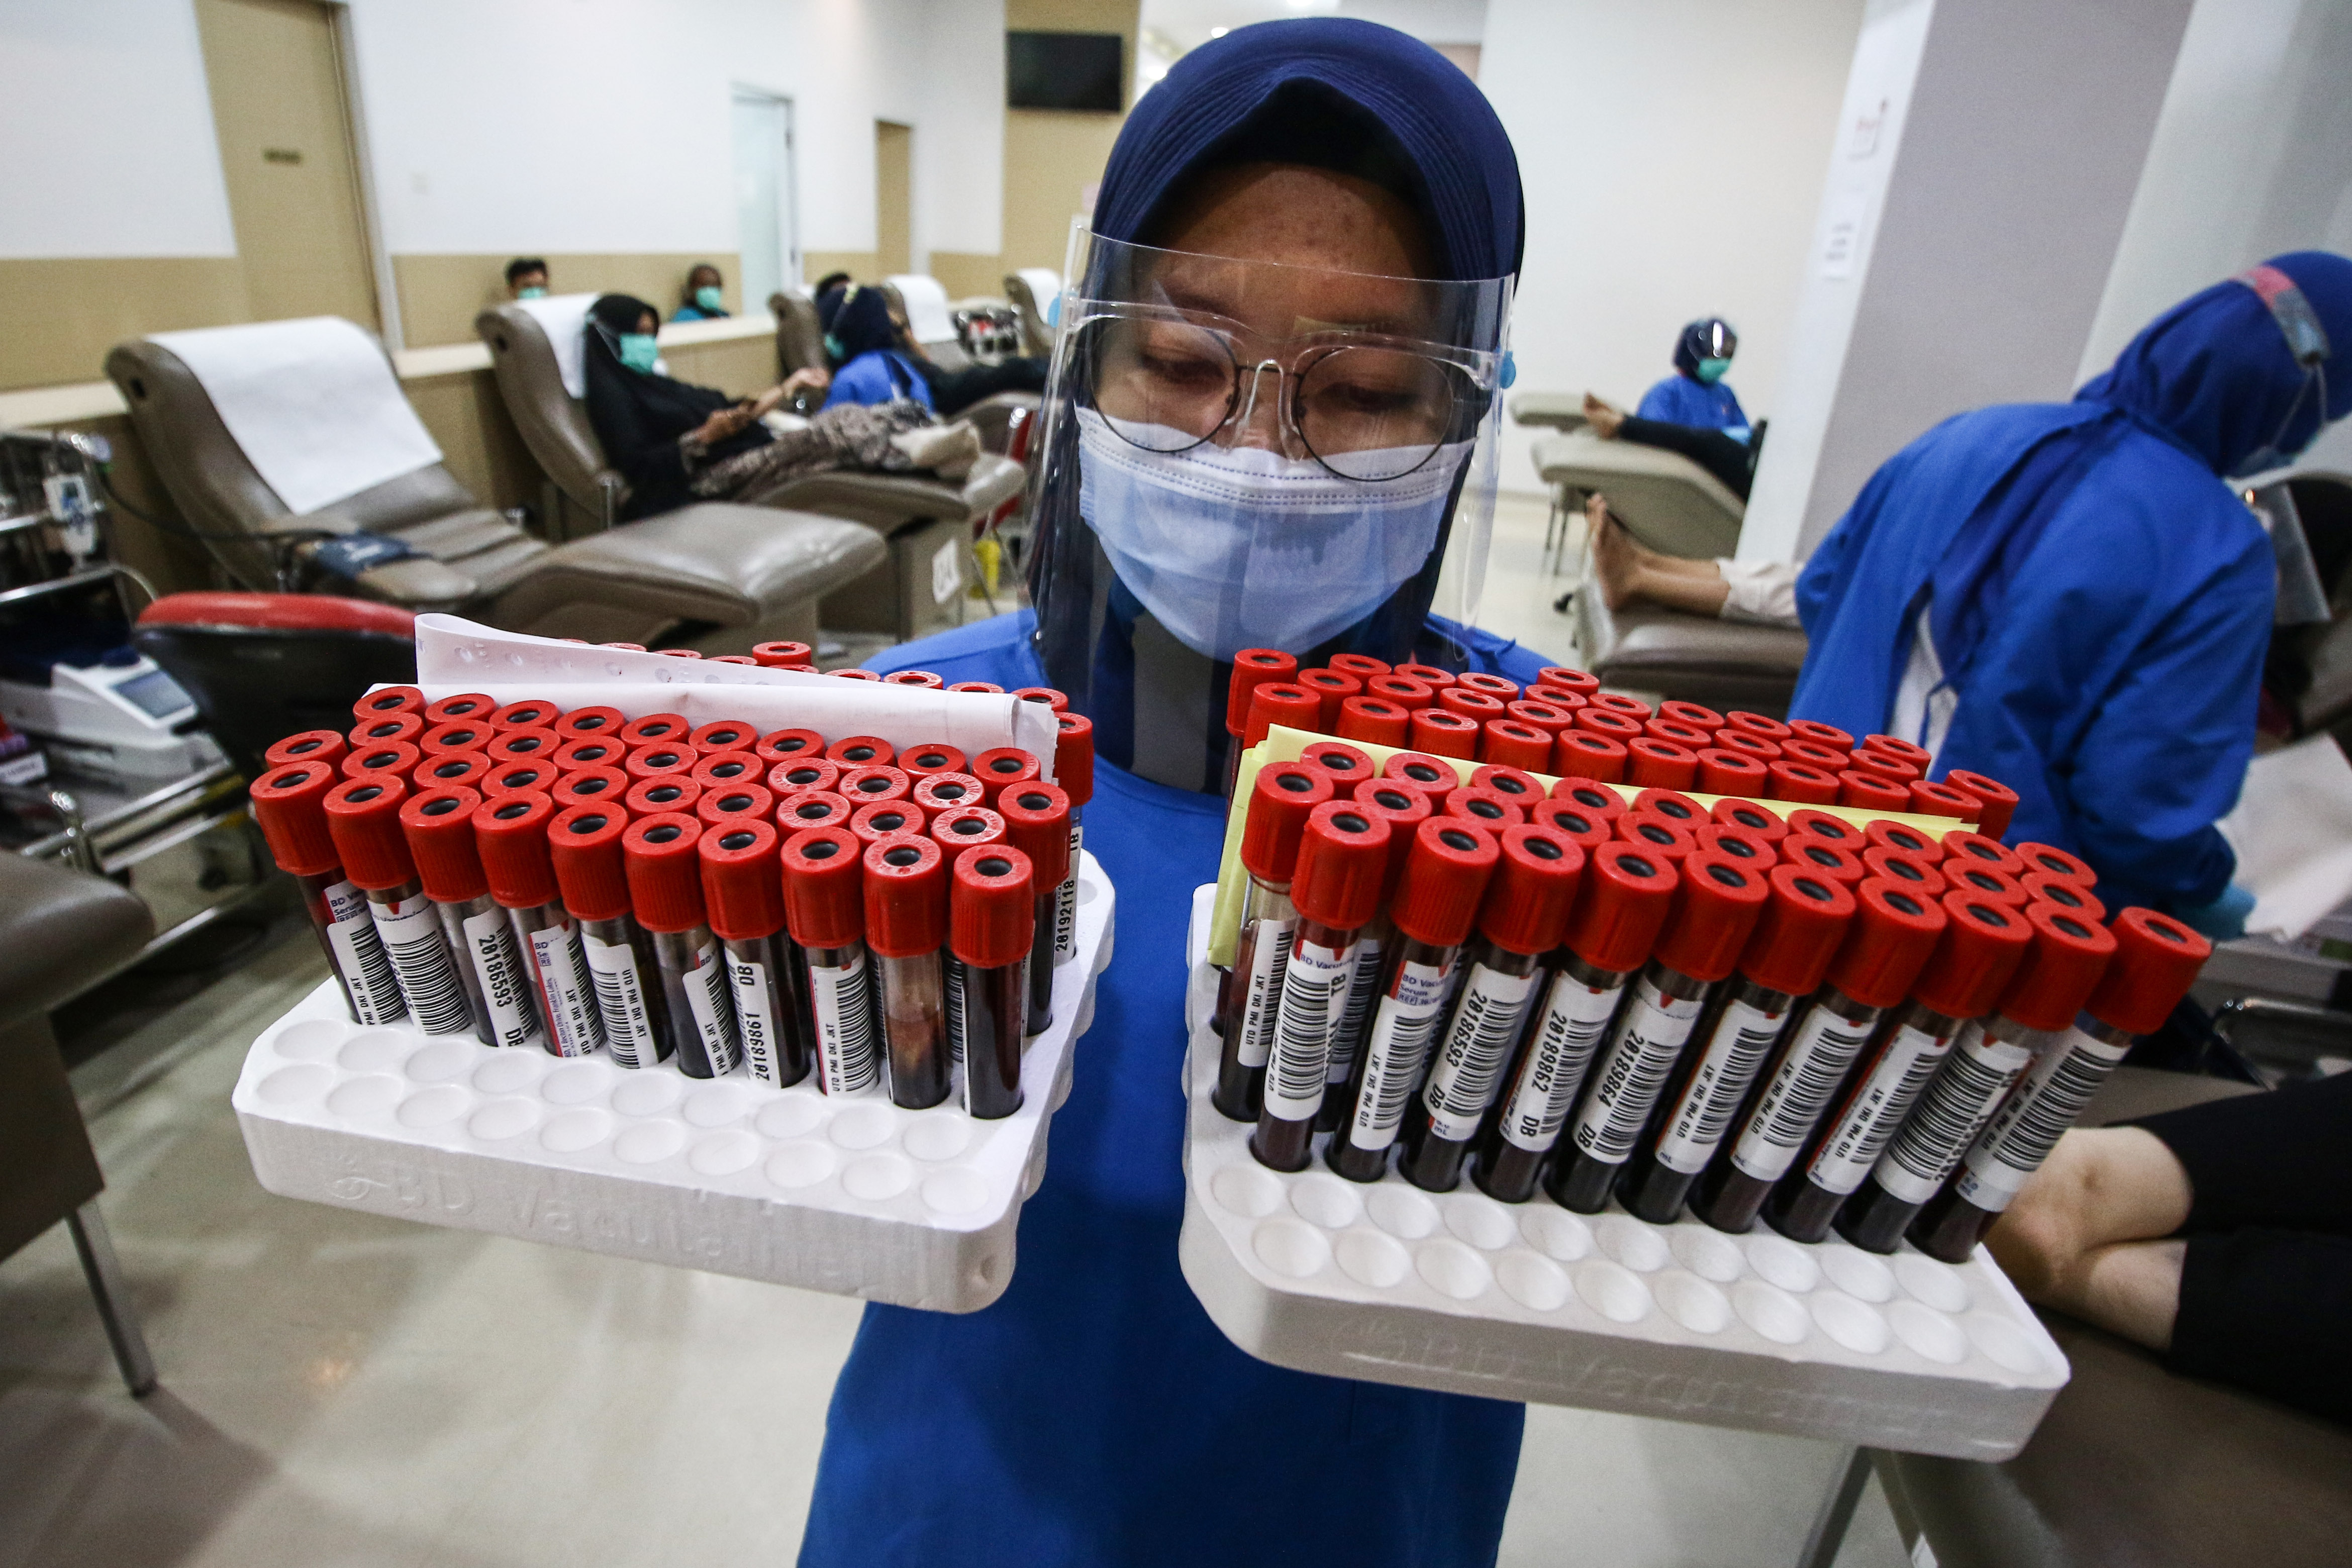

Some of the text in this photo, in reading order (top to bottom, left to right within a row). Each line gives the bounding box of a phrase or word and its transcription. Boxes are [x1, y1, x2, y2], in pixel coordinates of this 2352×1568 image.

[331, 898, 345, 907] BD
[1055, 879, 1074, 952] 20192118
[350, 977, 375, 1025] PMI DKI JKT
[478, 934, 513, 1007] 20186593
[566, 989, 576, 1002] JKT
[622, 969, 646, 1037] UTD PMI DKI JKT
[1331, 973, 1346, 997] TB
[1402, 974, 1416, 984] BD
[570, 1007, 581, 1020] DKI
[576, 1023, 586, 1038] PMI
[705, 1022, 716, 1036] JKT
[737, 965, 770, 1081] 20189861 DB
[1246, 975, 1264, 1045] UTD PMI DKI JKT
[1446, 989, 1488, 1067] 20186593
[711, 1039, 720, 1053] DKI
[716, 1055, 726, 1069] PMI
[826, 1023, 840, 1092] UTD PMI DKI JKT
[1520, 1010, 1567, 1138] 20189862 DB
[1359, 1054, 1381, 1127] UTD PMI DKI JKT
[1429, 1083, 1445, 1109] DB
[1577, 1028, 1644, 1149] 20189864 DB
[1677, 1063, 1715, 1138] UTD PMI DKI JKT
[1751, 1061, 1795, 1134] UTD PMI DKI JKT
[1835, 1088, 1884, 1157] UTD PMI DKI JKT
